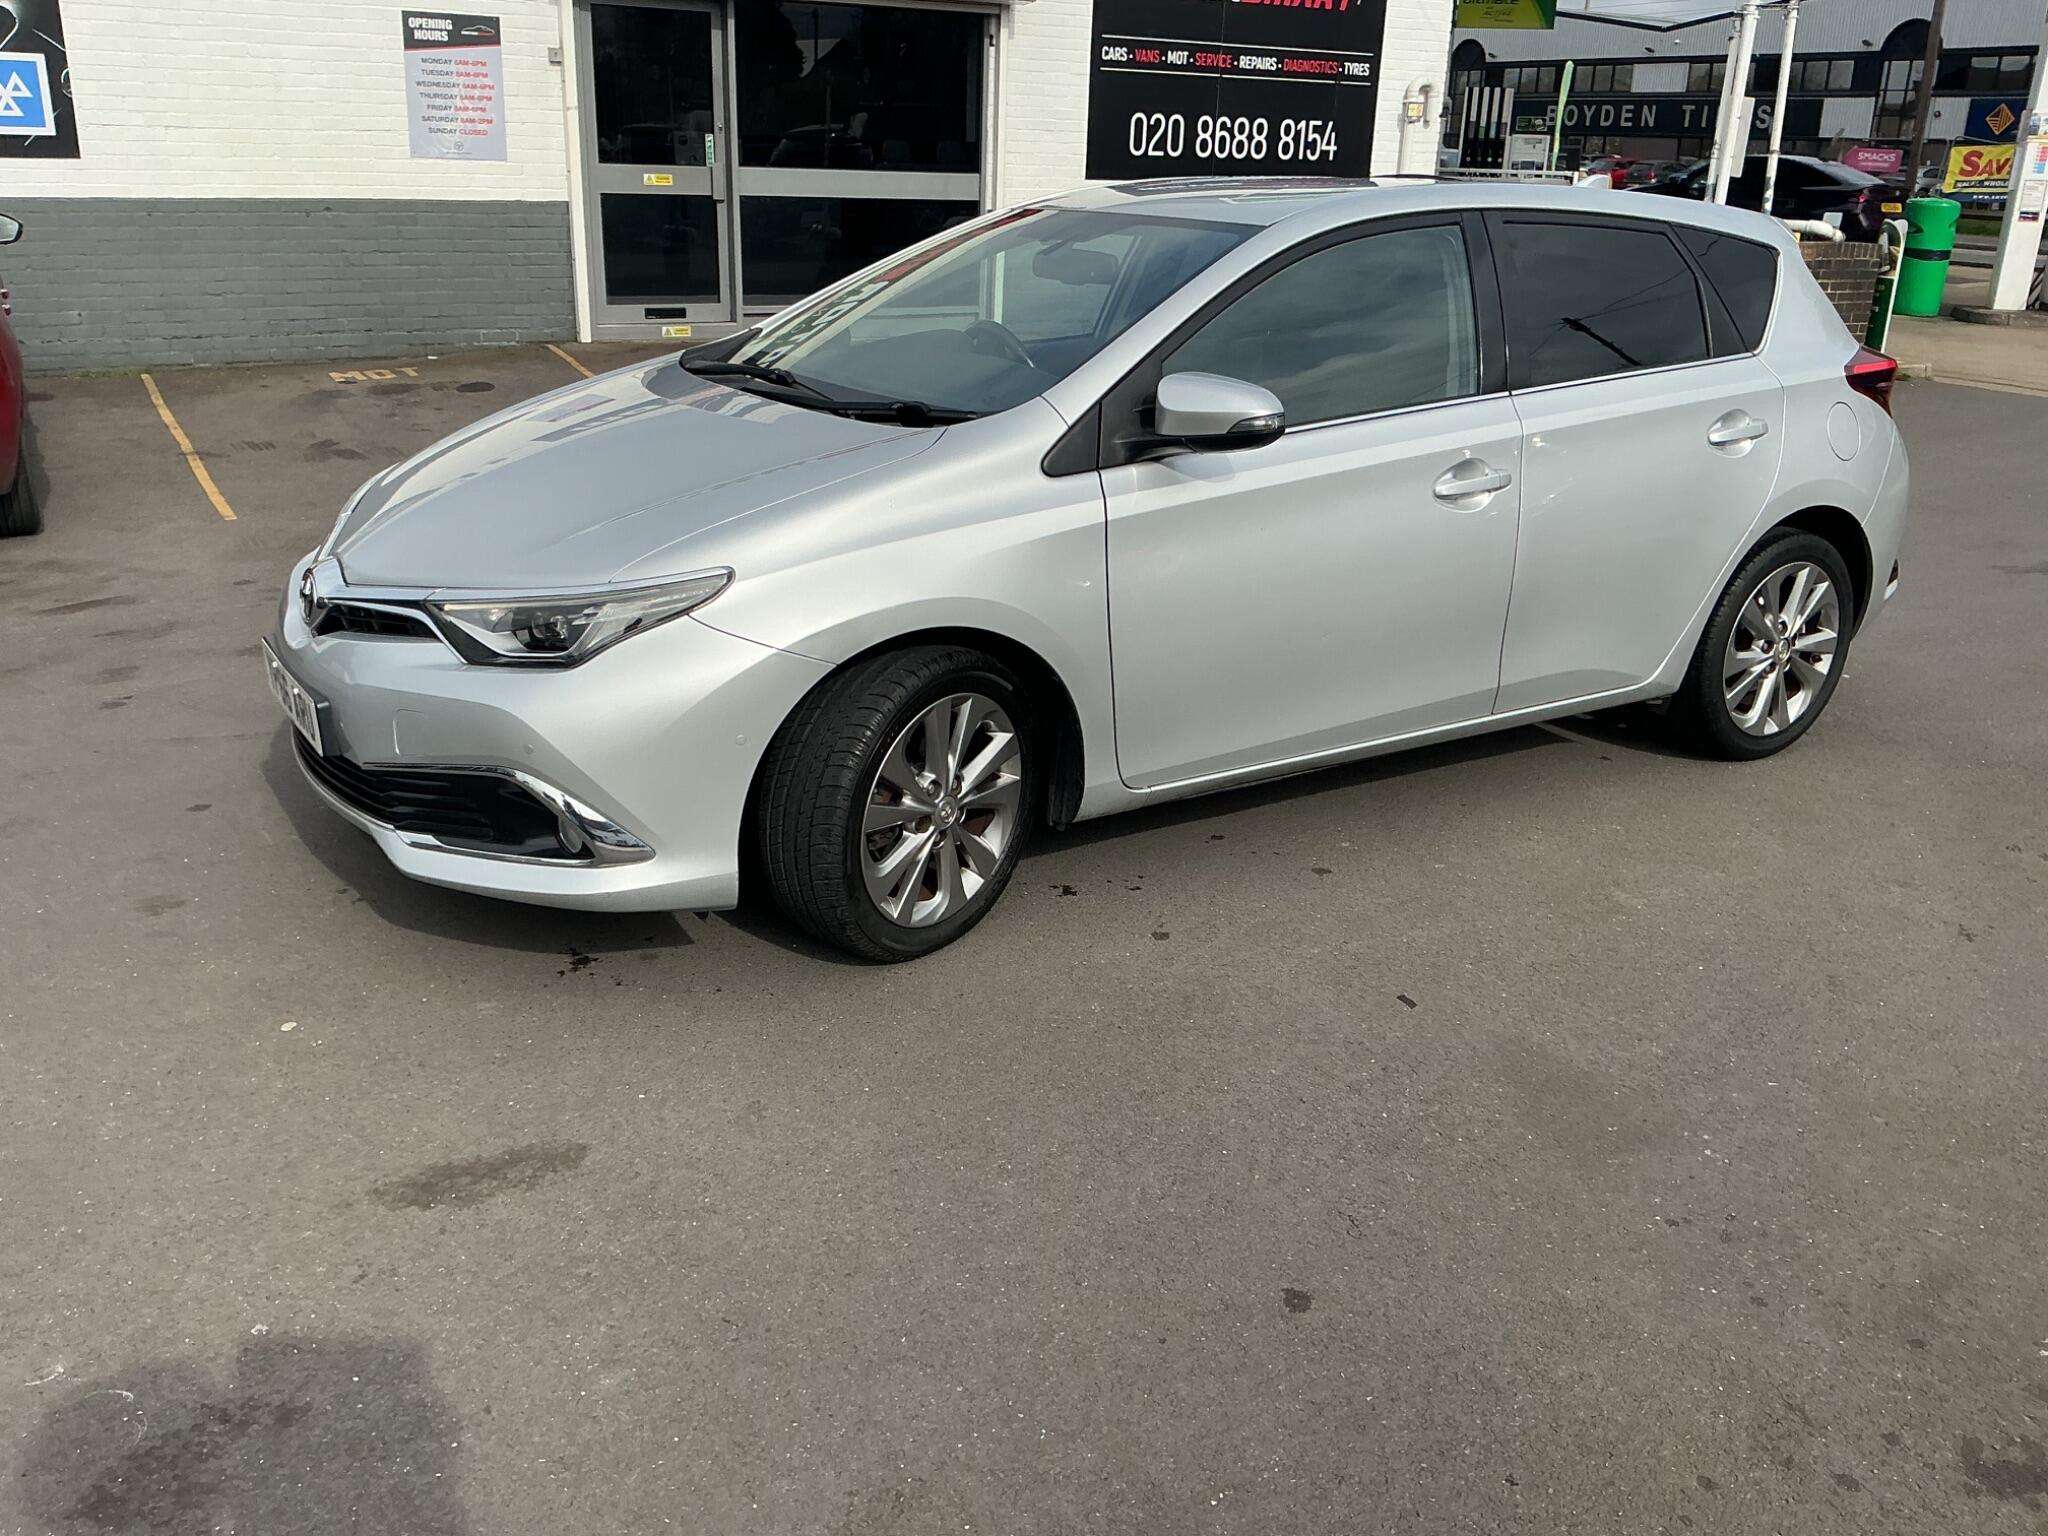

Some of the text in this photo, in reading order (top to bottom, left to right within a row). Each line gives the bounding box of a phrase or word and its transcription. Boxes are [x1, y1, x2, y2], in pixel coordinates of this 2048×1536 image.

[408, 17, 453, 30] OPENING
[413, 30, 449, 41] HOURS
[1102, 46, 1370, 77] CARS VANS MOT SERVICE REPAIRS DIAGNOSTICS TYRES
[419, 92, 458, 100] THURSDAY
[1682, 105, 1772, 129] TIS
[1129, 112, 1337, 162] 020 8688 8154
[328, 367, 419, 382] MOT
